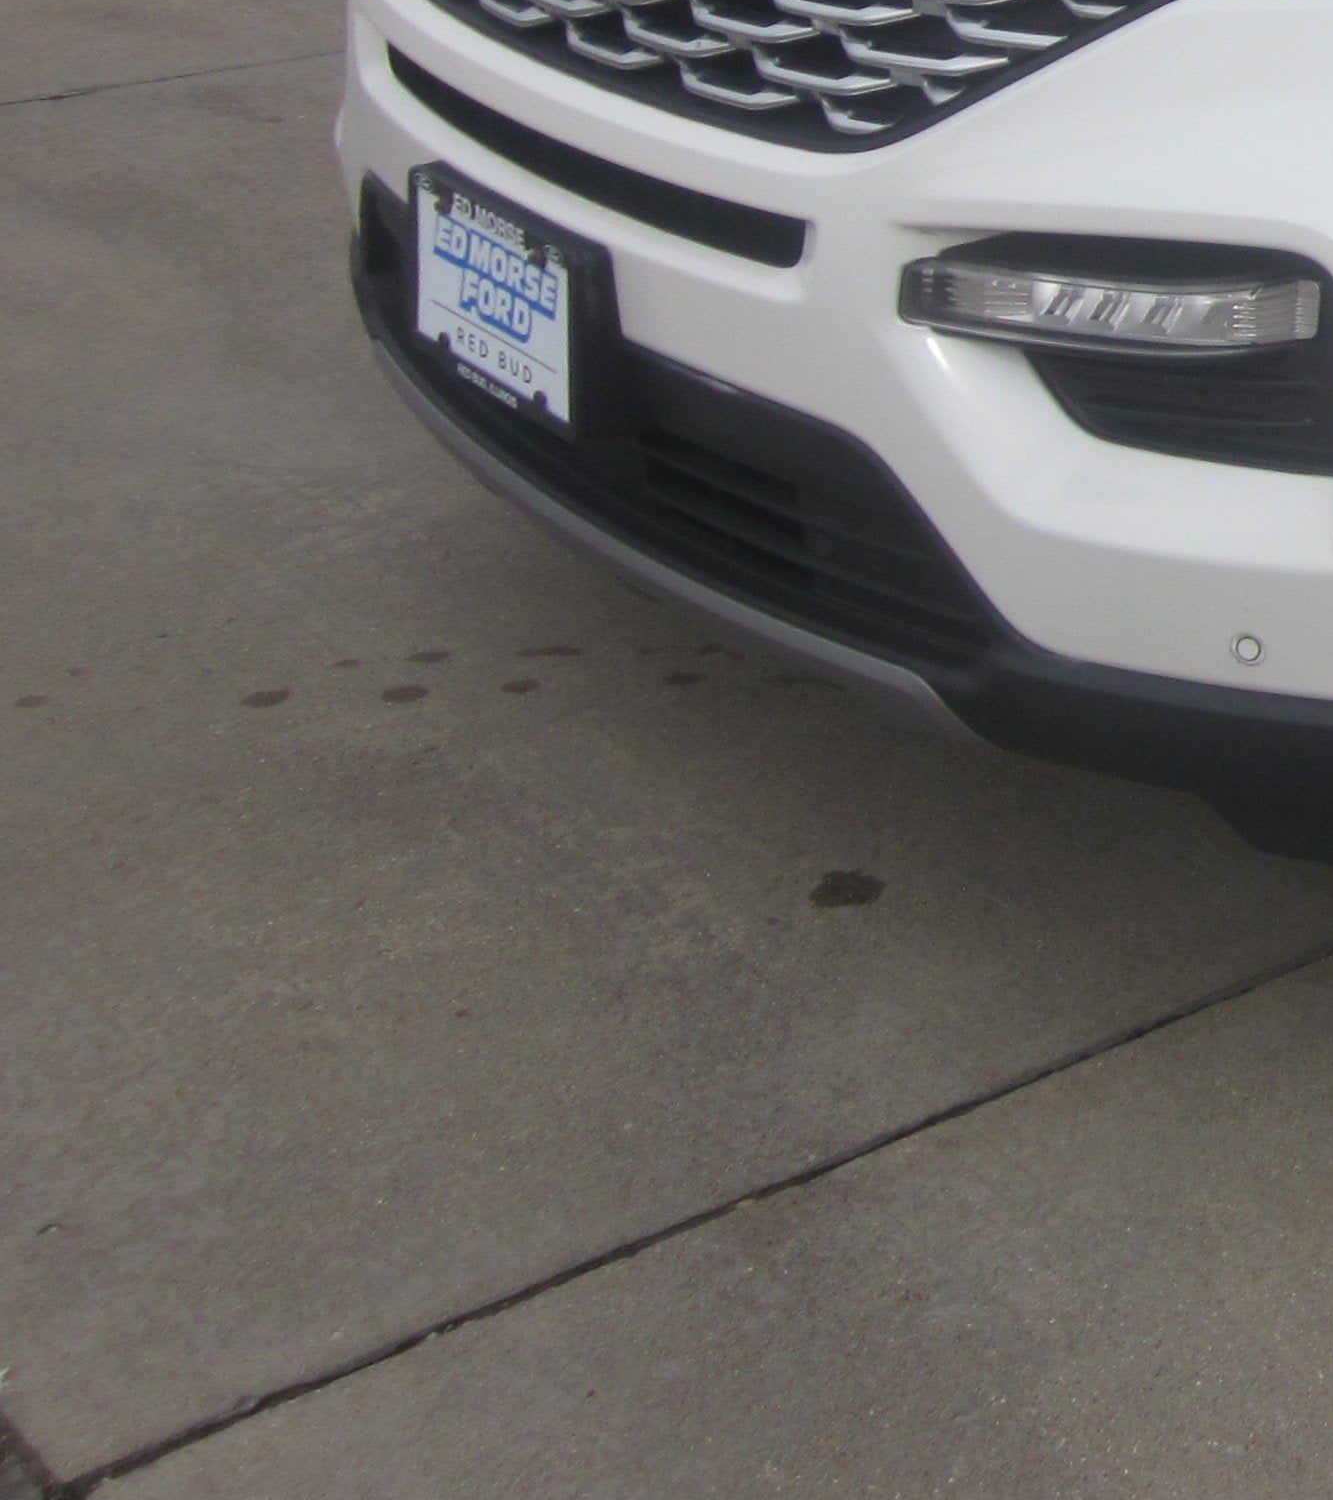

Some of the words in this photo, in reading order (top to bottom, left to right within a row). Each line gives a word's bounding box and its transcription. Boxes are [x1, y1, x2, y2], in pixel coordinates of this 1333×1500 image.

[435, 214, 469, 263] ED
[468, 228, 558, 318] MORSE
[460, 268, 533, 342] FORD
[457, 326, 489, 358] RED
[498, 350, 533, 384] BUD
